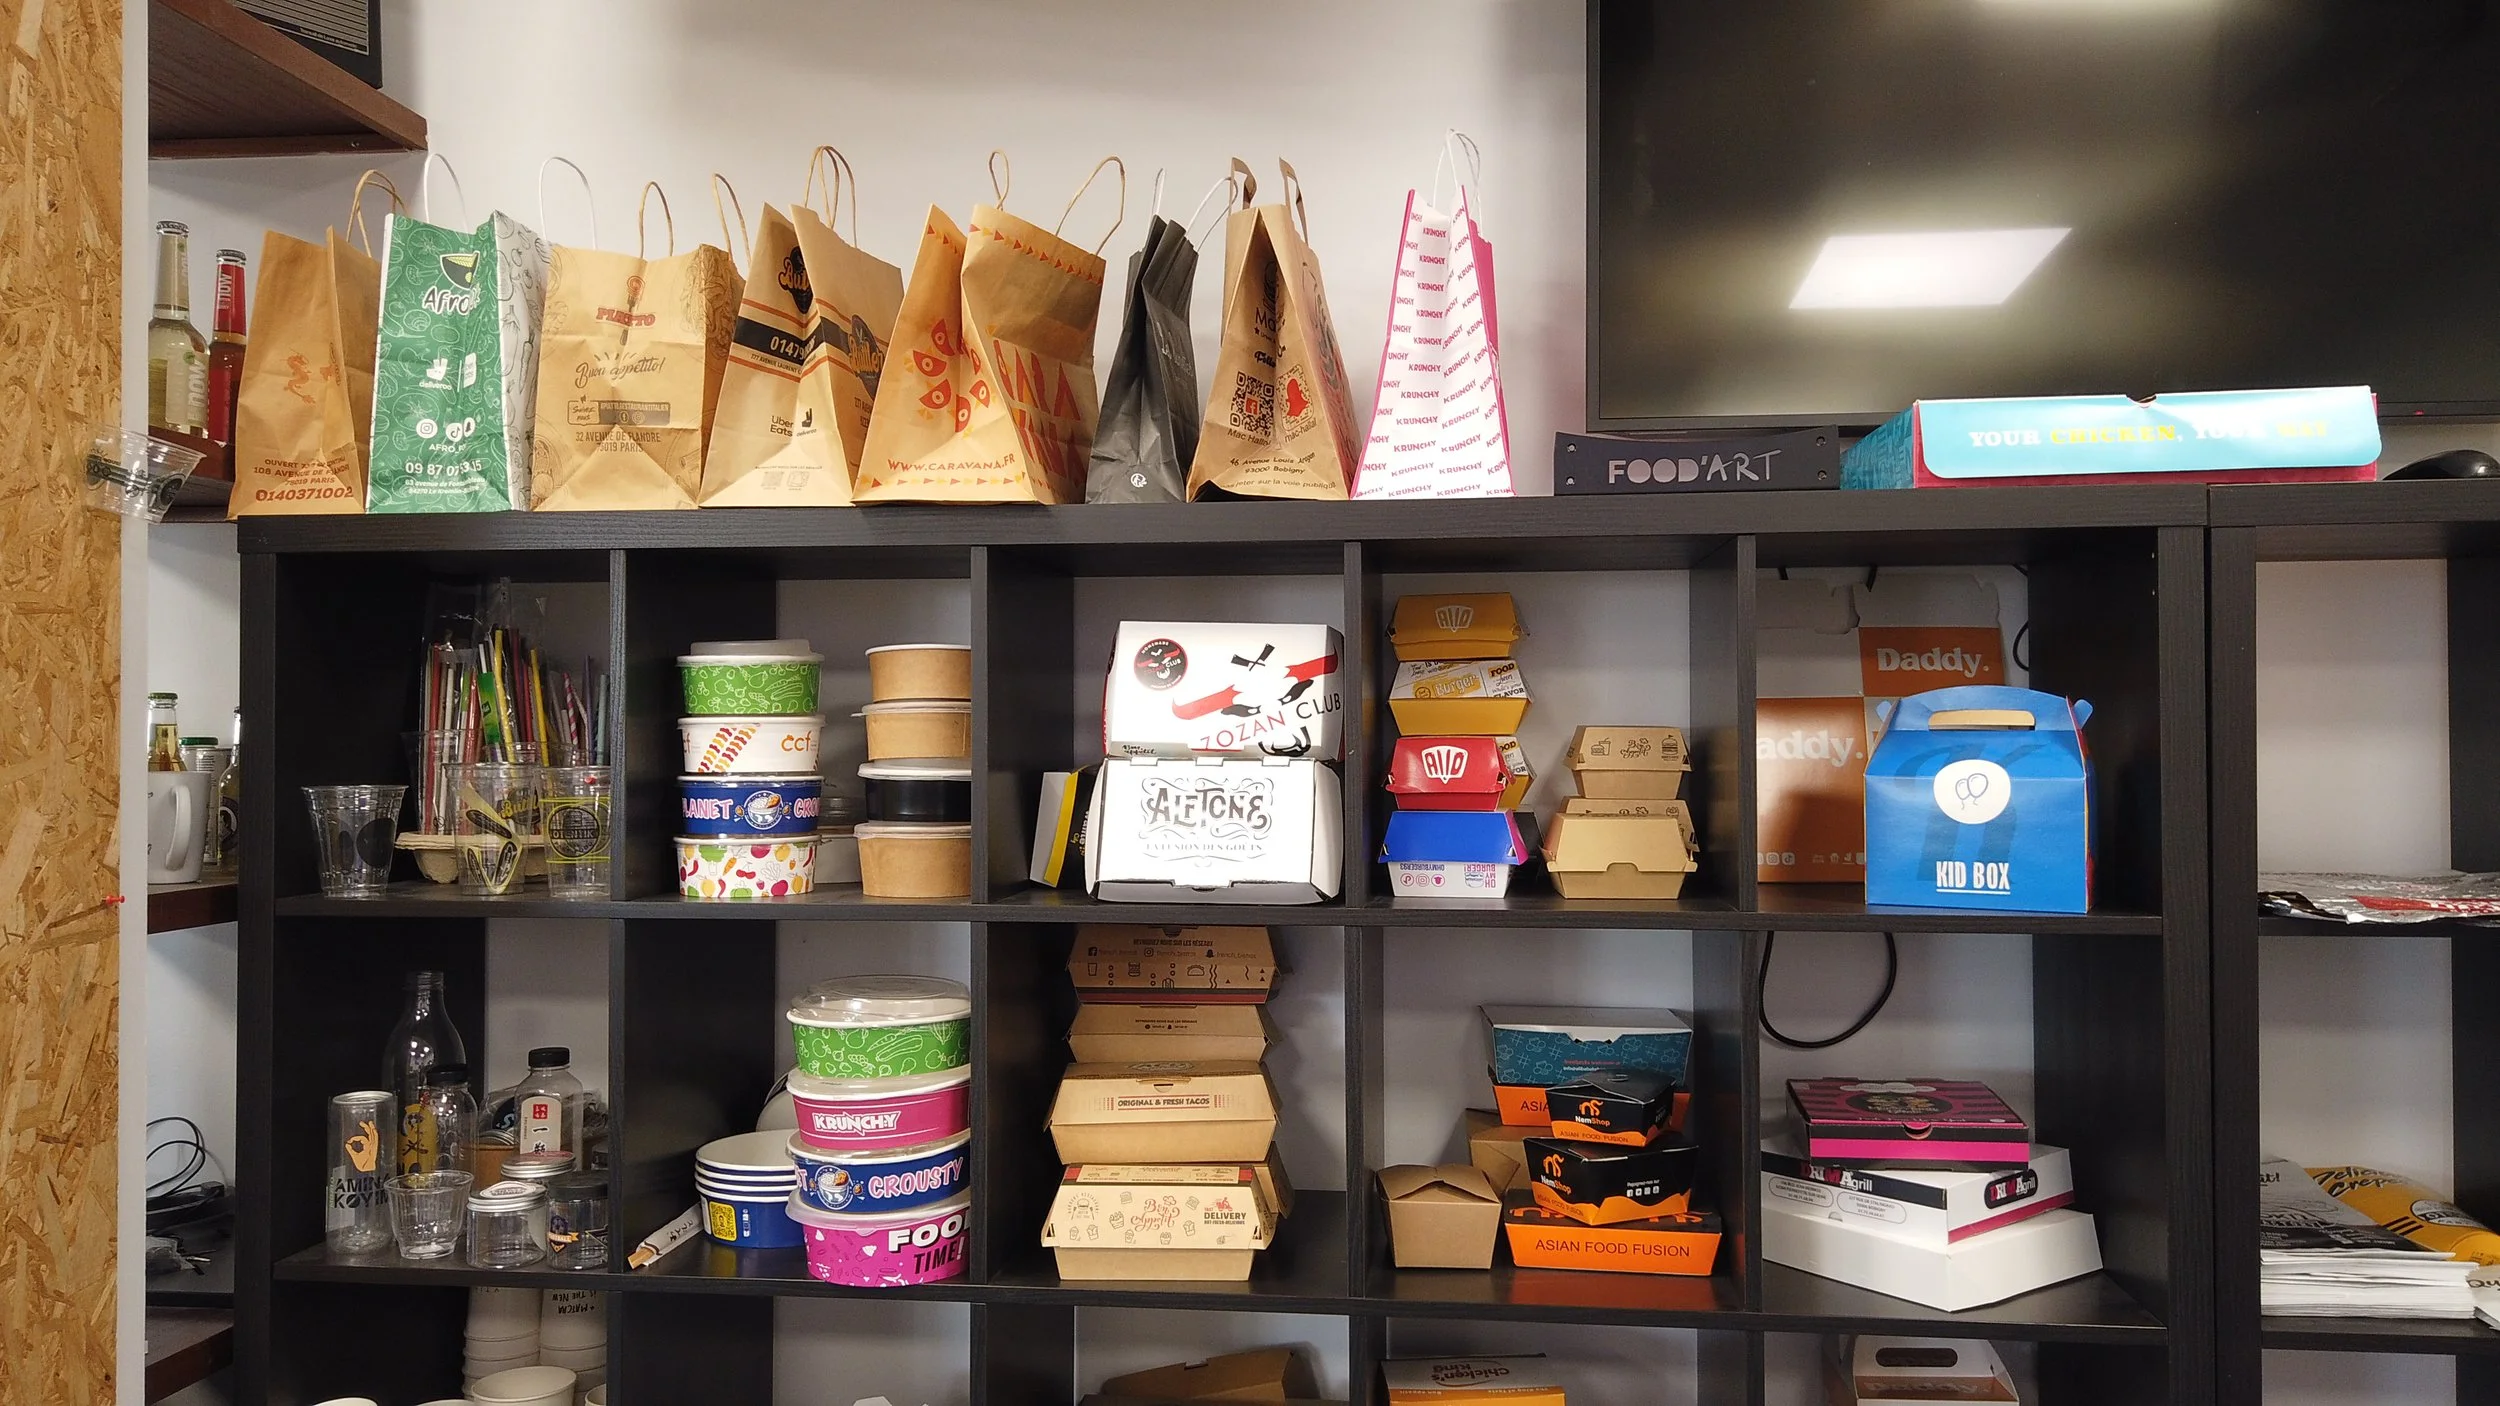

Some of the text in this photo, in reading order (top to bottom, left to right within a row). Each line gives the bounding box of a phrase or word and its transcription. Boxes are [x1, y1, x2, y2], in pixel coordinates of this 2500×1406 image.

[1423, 228, 1446, 238] KRUNCHY
[1419, 255, 1445, 264] KRUNCHY
[1417, 282, 1444, 292] KRUNCHY
[1416, 309, 1442, 319] KRUNCHY
[1414, 336, 1442, 346] KRUNCHY
[760, 356, 776, 367] AVENUE
[1408, 364, 1441, 372] KRUNCHY
[1443, 352, 1471, 378] KRUNCHY
[1401, 391, 1440, 399] KRUNCHY
[1444, 379, 1477, 404] KRUNCHY
[772, 415, 794, 428] Uber
[1396, 416, 1438, 426] KRUNCHY
[1442, 406, 1480, 430] KRUNCHY
[576, 432, 662, 442] 32 AVENUE DE FLANDRE
[770, 424, 794, 437] Eats
[1228, 428, 1246, 440] Mac
[1968, 430, 2040, 447] YOUR
[2050, 424, 2184, 444] CHICKEN,
[1394, 440, 1436, 453] KRUNCHY
[1441, 434, 1481, 453] KRUNCHY
[265, 458, 298, 468] OUVERT
[1230, 458, 1240, 466] 46
[1608, 450, 1782, 484] FOOD'ART
[275, 469, 310, 478] AVENUE
[405, 462, 423, 474] 09
[427, 464, 443, 476] 87
[1274, 466, 1306, 475] Bobigny
[1392, 462, 1434, 478] KRUNCHY
[1439, 461, 1482, 475] KRUNCHY
[256, 486, 354, 502] 0140371002
[1388, 484, 1480, 497] KRUNCHY KRUNCHY
[1166, 658, 1182, 668] CLUB
[1876, 647, 1990, 678] Daddy.
[1490, 663, 1515, 678] FOOD
[1200, 692, 1342, 751] ZOZAN CLUB
[682, 798, 734, 820] LANET
[1936, 861, 2011, 891] KID BOX
[1484, 879, 1496, 888] OH
[1118, 1097, 1210, 1107] ORIGINAL & FRESH TACOS
[812, 1111, 901, 1136] KRUNCHY
[1575, 1116, 1610, 1128] NemShop
[1604, 1134, 1628, 1143] FUSION
[868, 1157, 964, 1199] CROUSTY
[1541, 1174, 1572, 1195] NemShop
[1204, 1212, 1246, 1220] DELIVERY
[888, 1213, 970, 1252] FOO
[1535, 1239, 1690, 1258] ASIAN FOOD FUSION
[913, 1236, 964, 1275] TIME!
[552, 1292, 586, 1302] THE NEW
[1432, 1367, 1510, 1382] Chicken's
[1433, 1363, 1472, 1373] King
